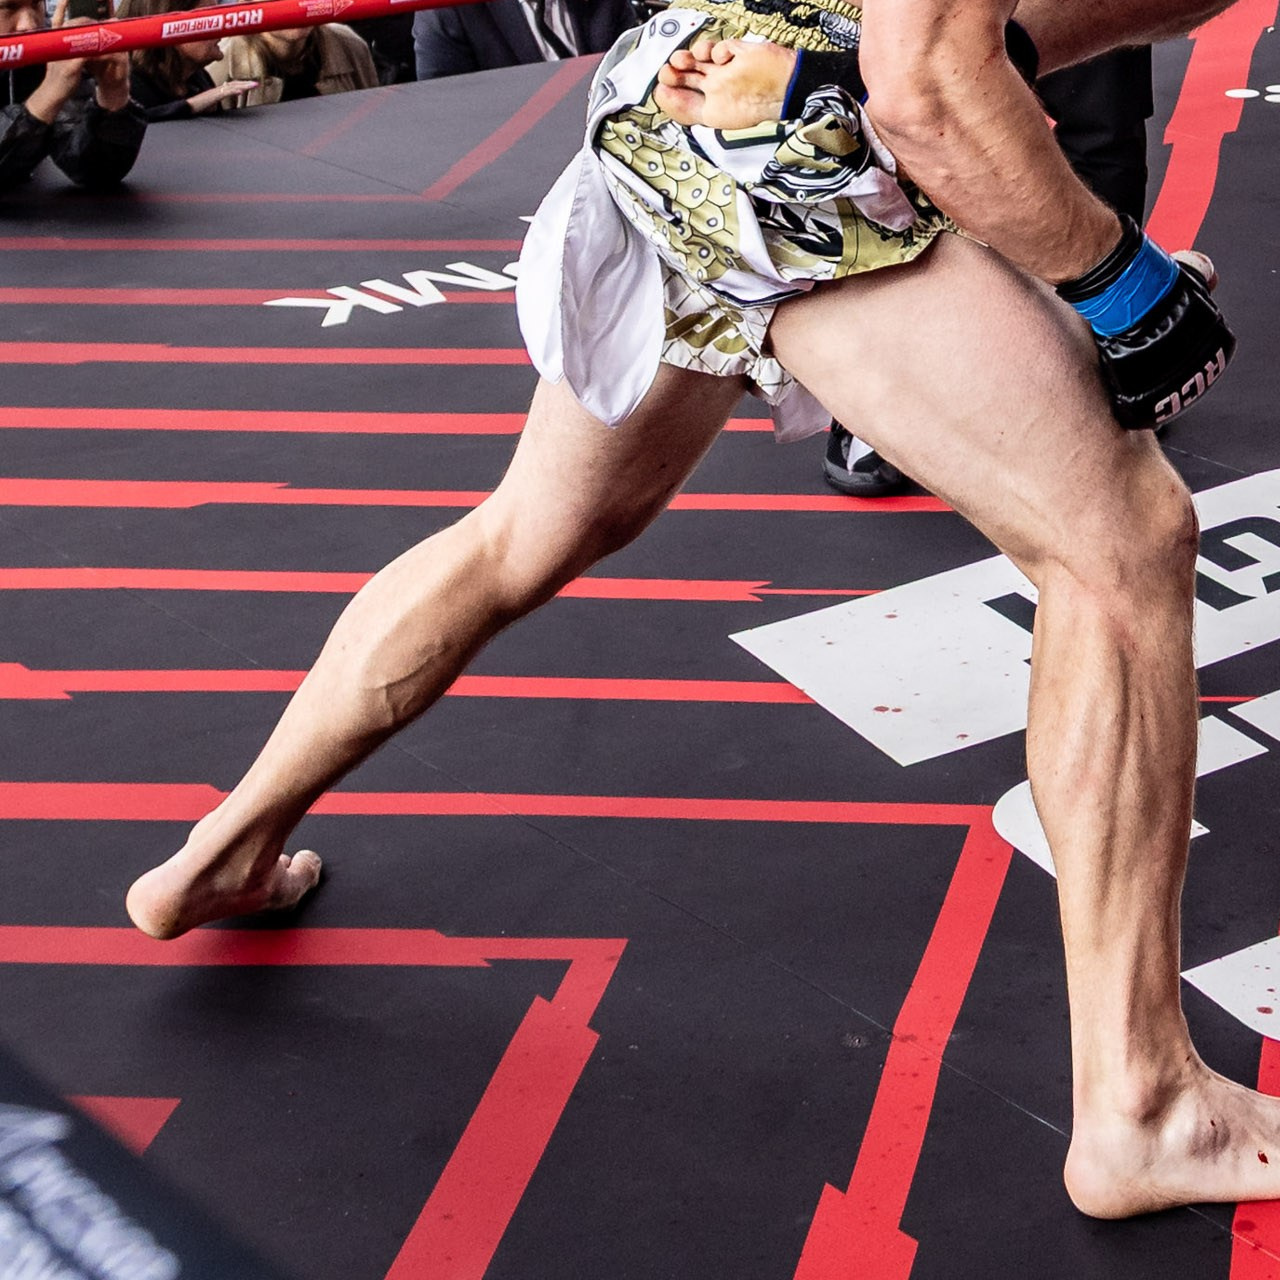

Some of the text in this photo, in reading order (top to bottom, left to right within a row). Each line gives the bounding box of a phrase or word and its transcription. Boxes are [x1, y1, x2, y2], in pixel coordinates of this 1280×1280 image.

[164, 9, 262, 38] RCC FAIRFIGHT
[263, 261, 519, 328] МК
[1155, 347, 1226, 423] RCC
